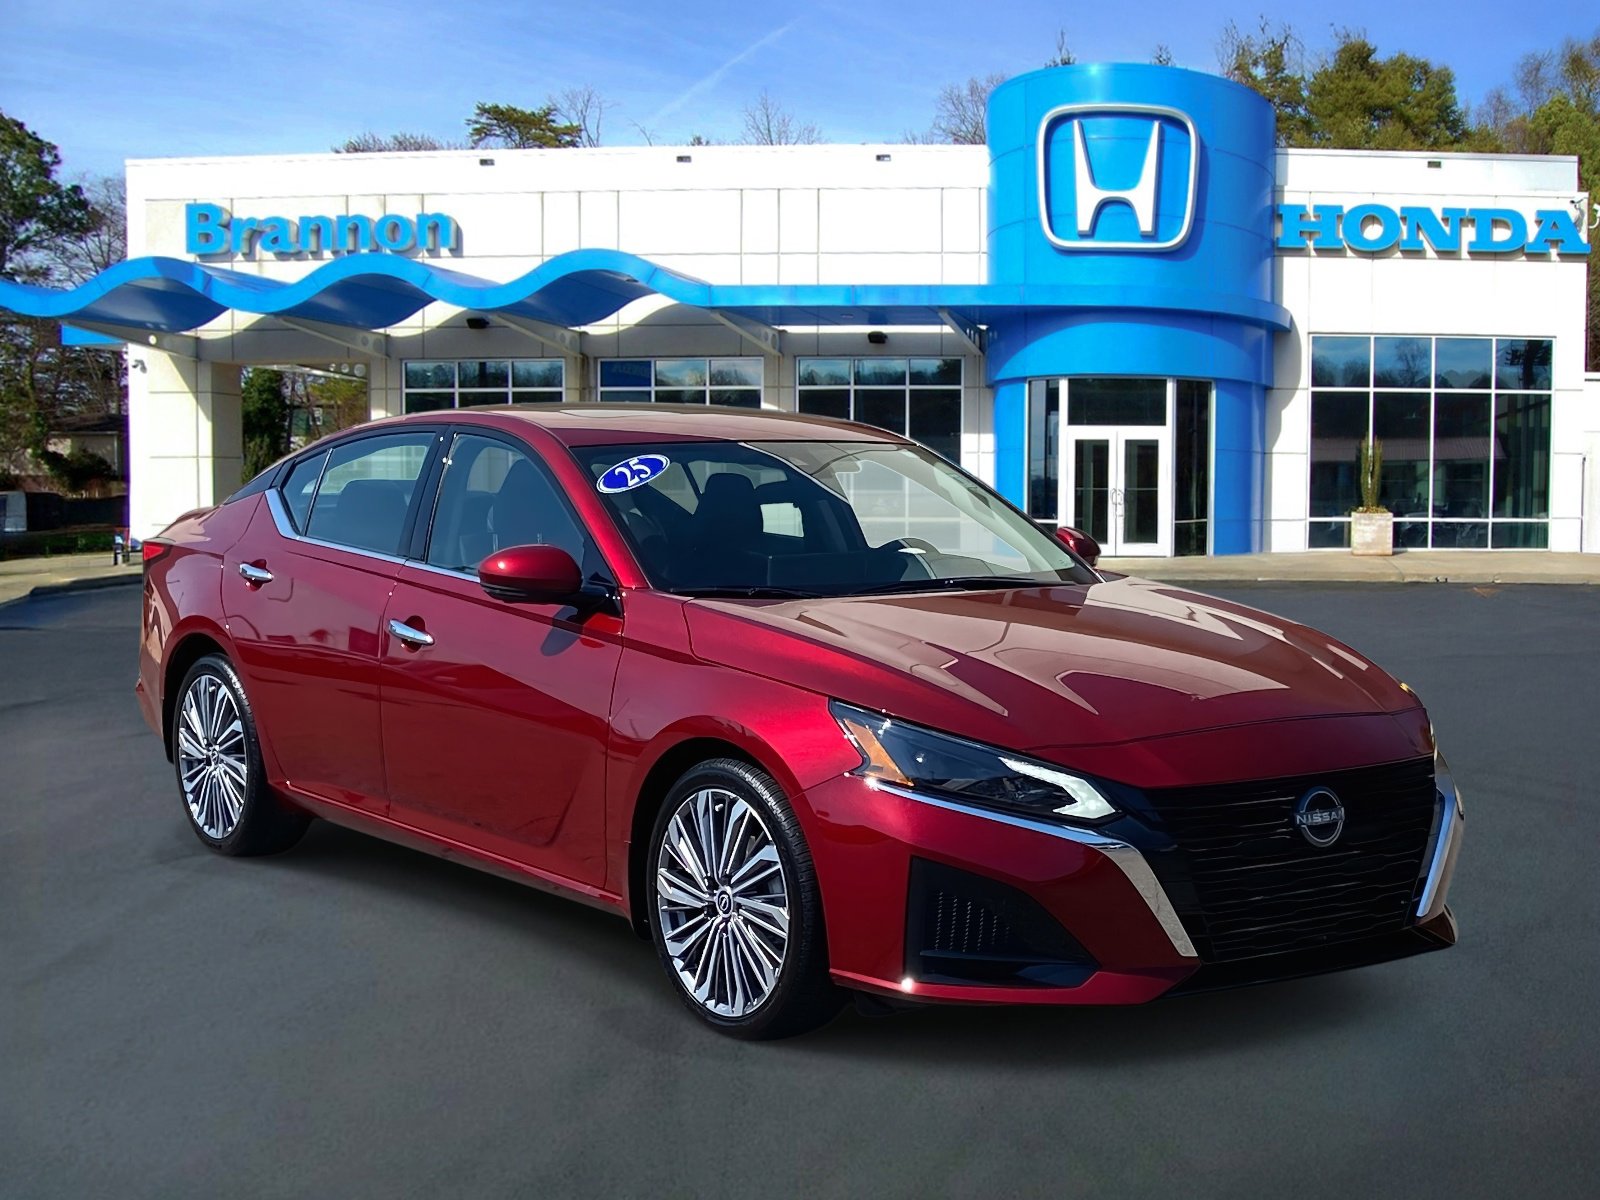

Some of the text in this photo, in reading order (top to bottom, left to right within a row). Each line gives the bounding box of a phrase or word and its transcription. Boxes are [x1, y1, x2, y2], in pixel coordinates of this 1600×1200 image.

[185, 202, 459, 256] Brannon
[1277, 203, 1591, 254] HONDA
[615, 458, 651, 486] 25
